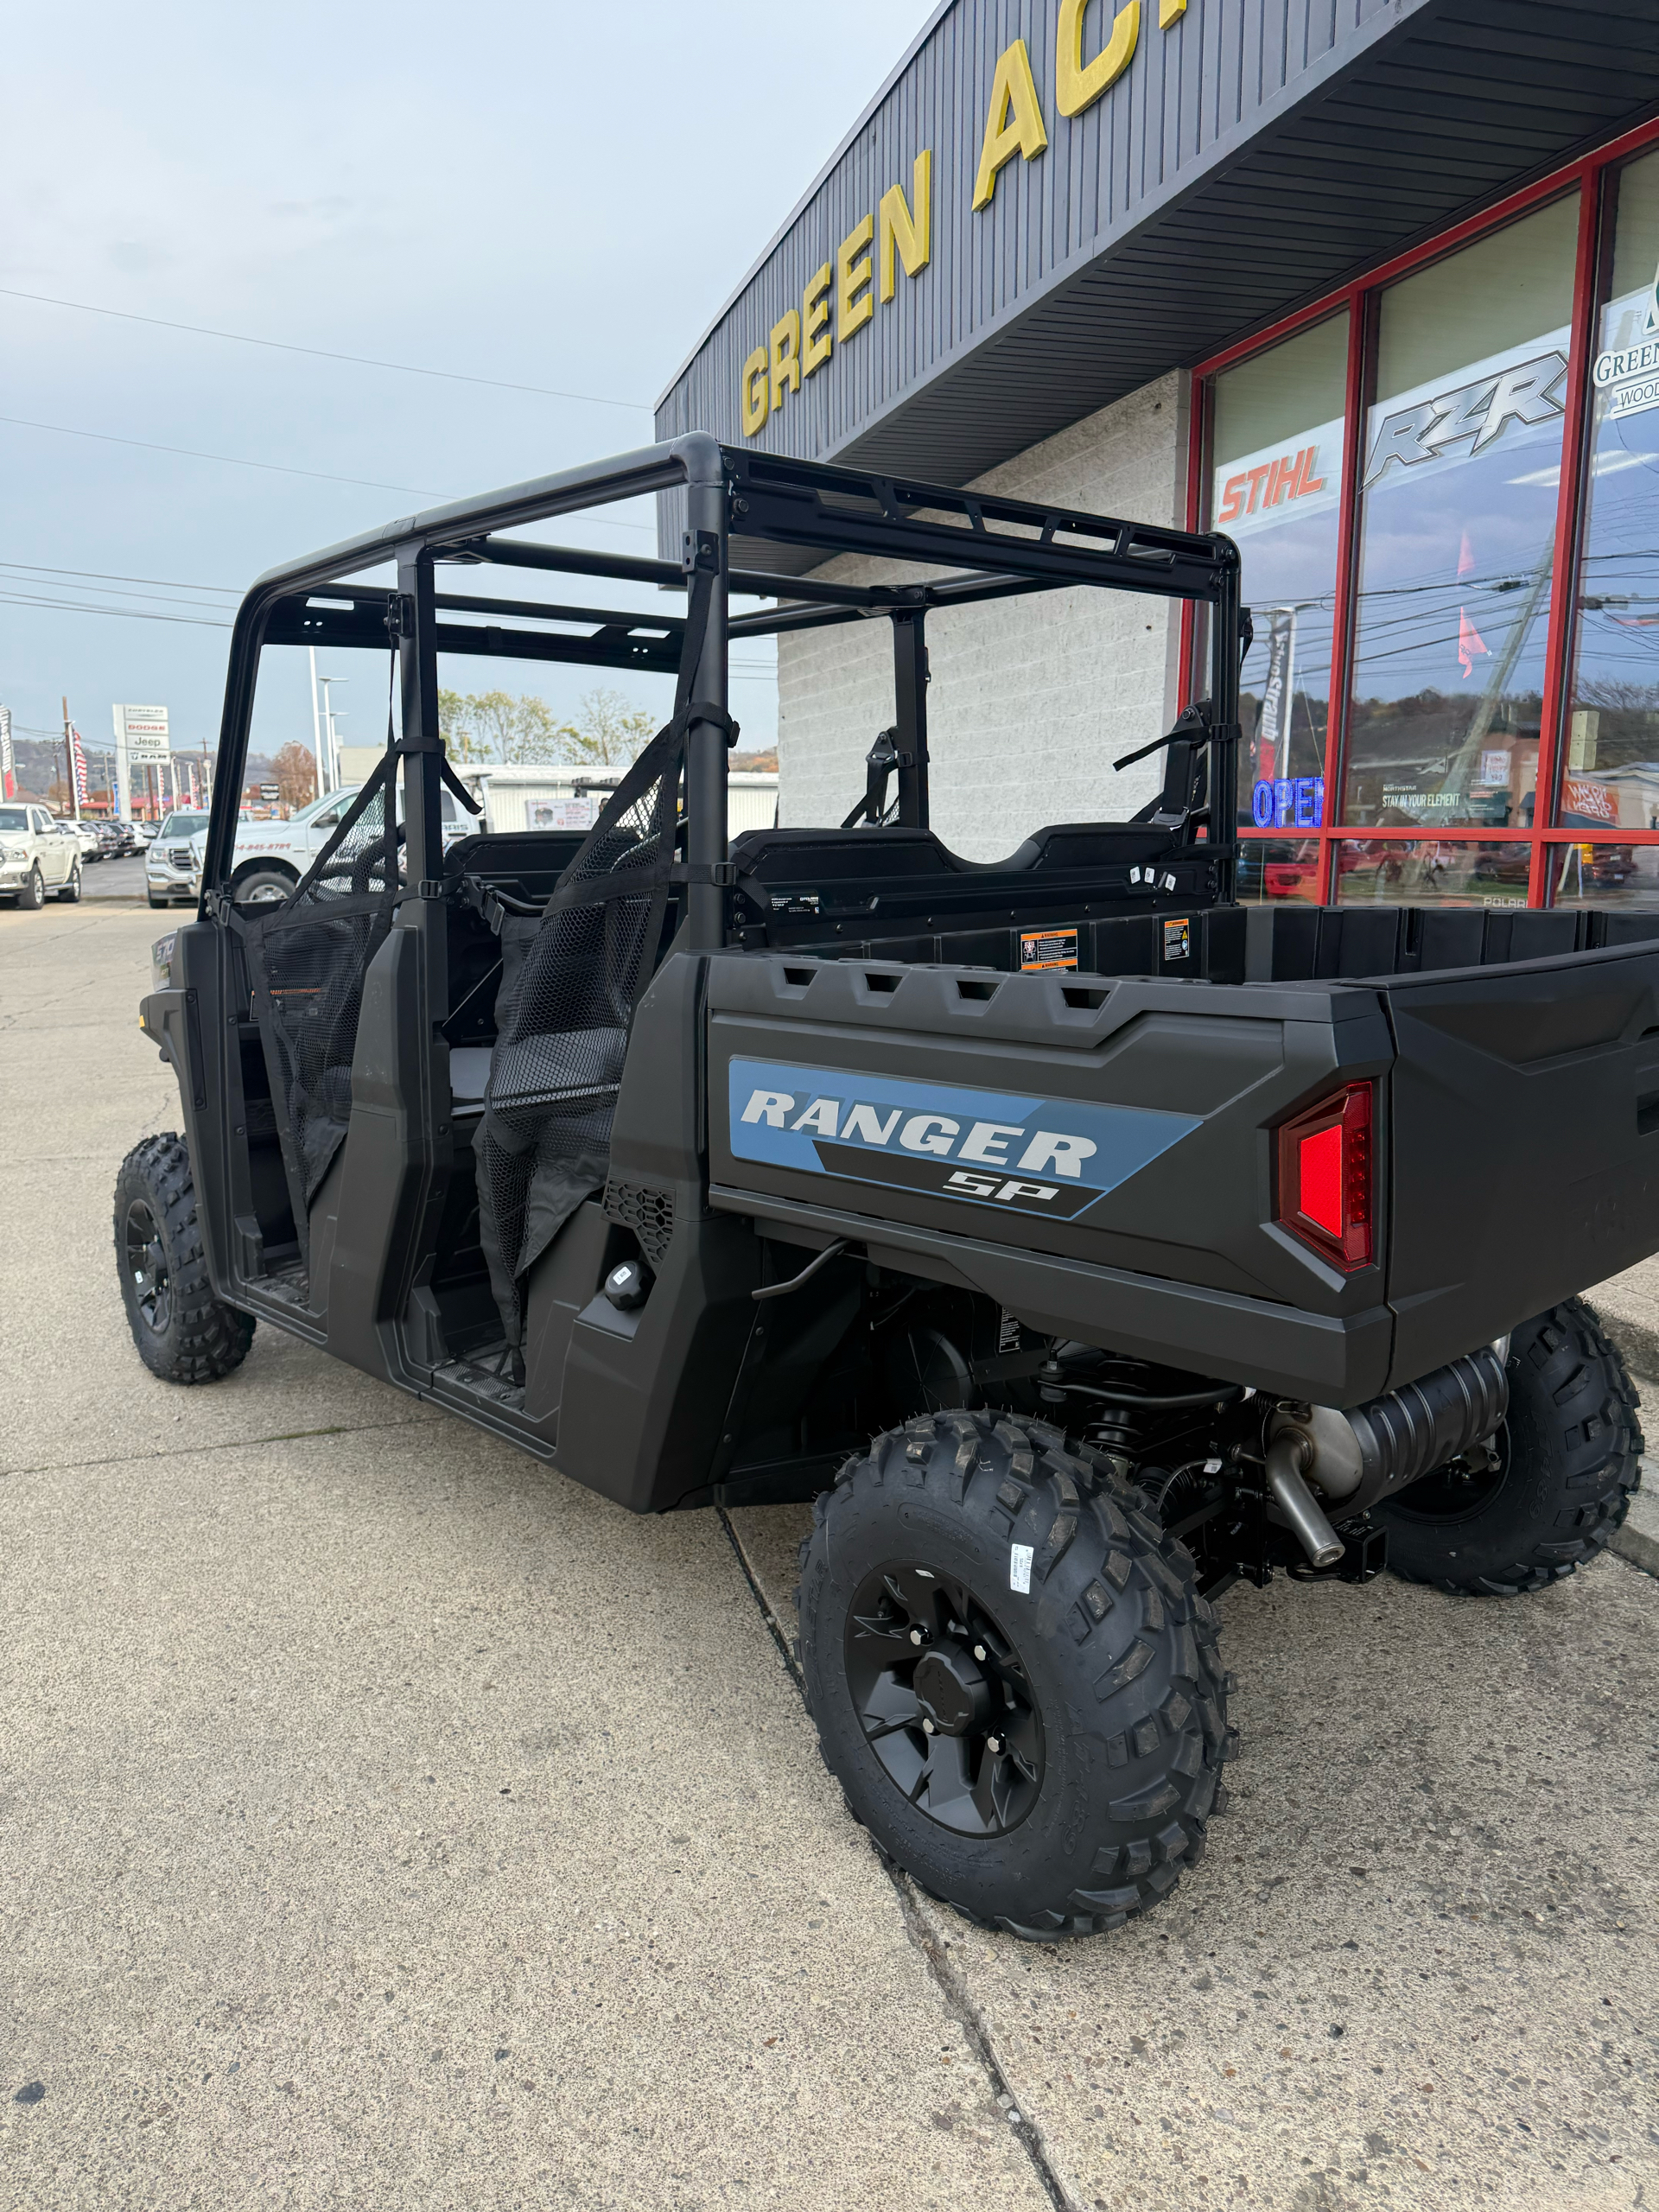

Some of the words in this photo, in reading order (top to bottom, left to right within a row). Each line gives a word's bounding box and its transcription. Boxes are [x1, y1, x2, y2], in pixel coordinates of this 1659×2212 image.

[741, 149, 931, 437] GREEN
[971, 0, 1187, 213] AC
[1358, 350, 1569, 494] RZR
[1218, 445, 1325, 524] STIHL
[134, 736, 161, 747] Jeep
[1382, 795, 1398, 808] STAY
[1408, 794, 1427, 807] YOUR
[1427, 792, 1460, 806] ELEMENT
[741, 1089, 1097, 1178] RANGER
[943, 1171, 1059, 1201] SP
